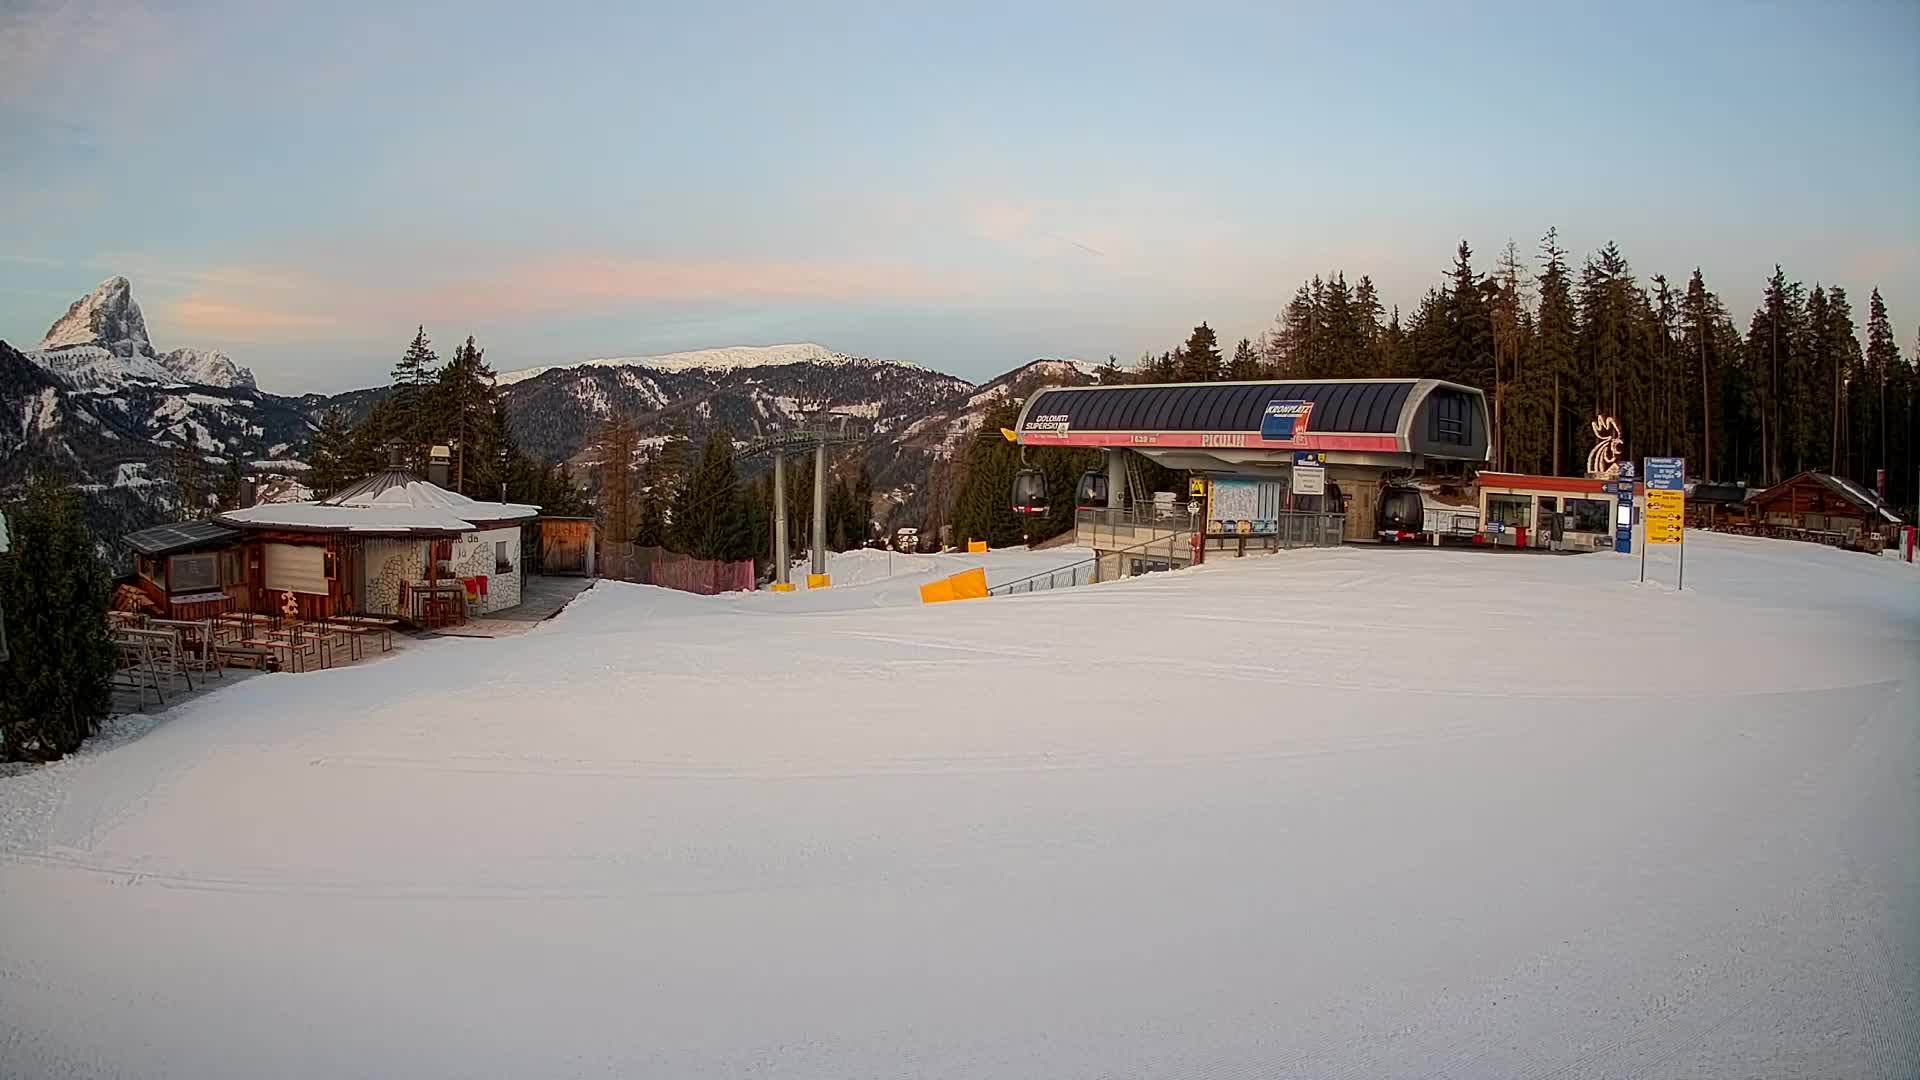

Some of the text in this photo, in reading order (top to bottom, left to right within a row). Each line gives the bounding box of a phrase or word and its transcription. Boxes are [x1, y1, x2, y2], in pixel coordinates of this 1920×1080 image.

[1265, 405, 1313, 414] KRONPLATZ
[1025, 422, 1059, 430] SUPERSKI
[1201, 434, 1246, 447] PICULIN
[468, 534, 479, 543] da
